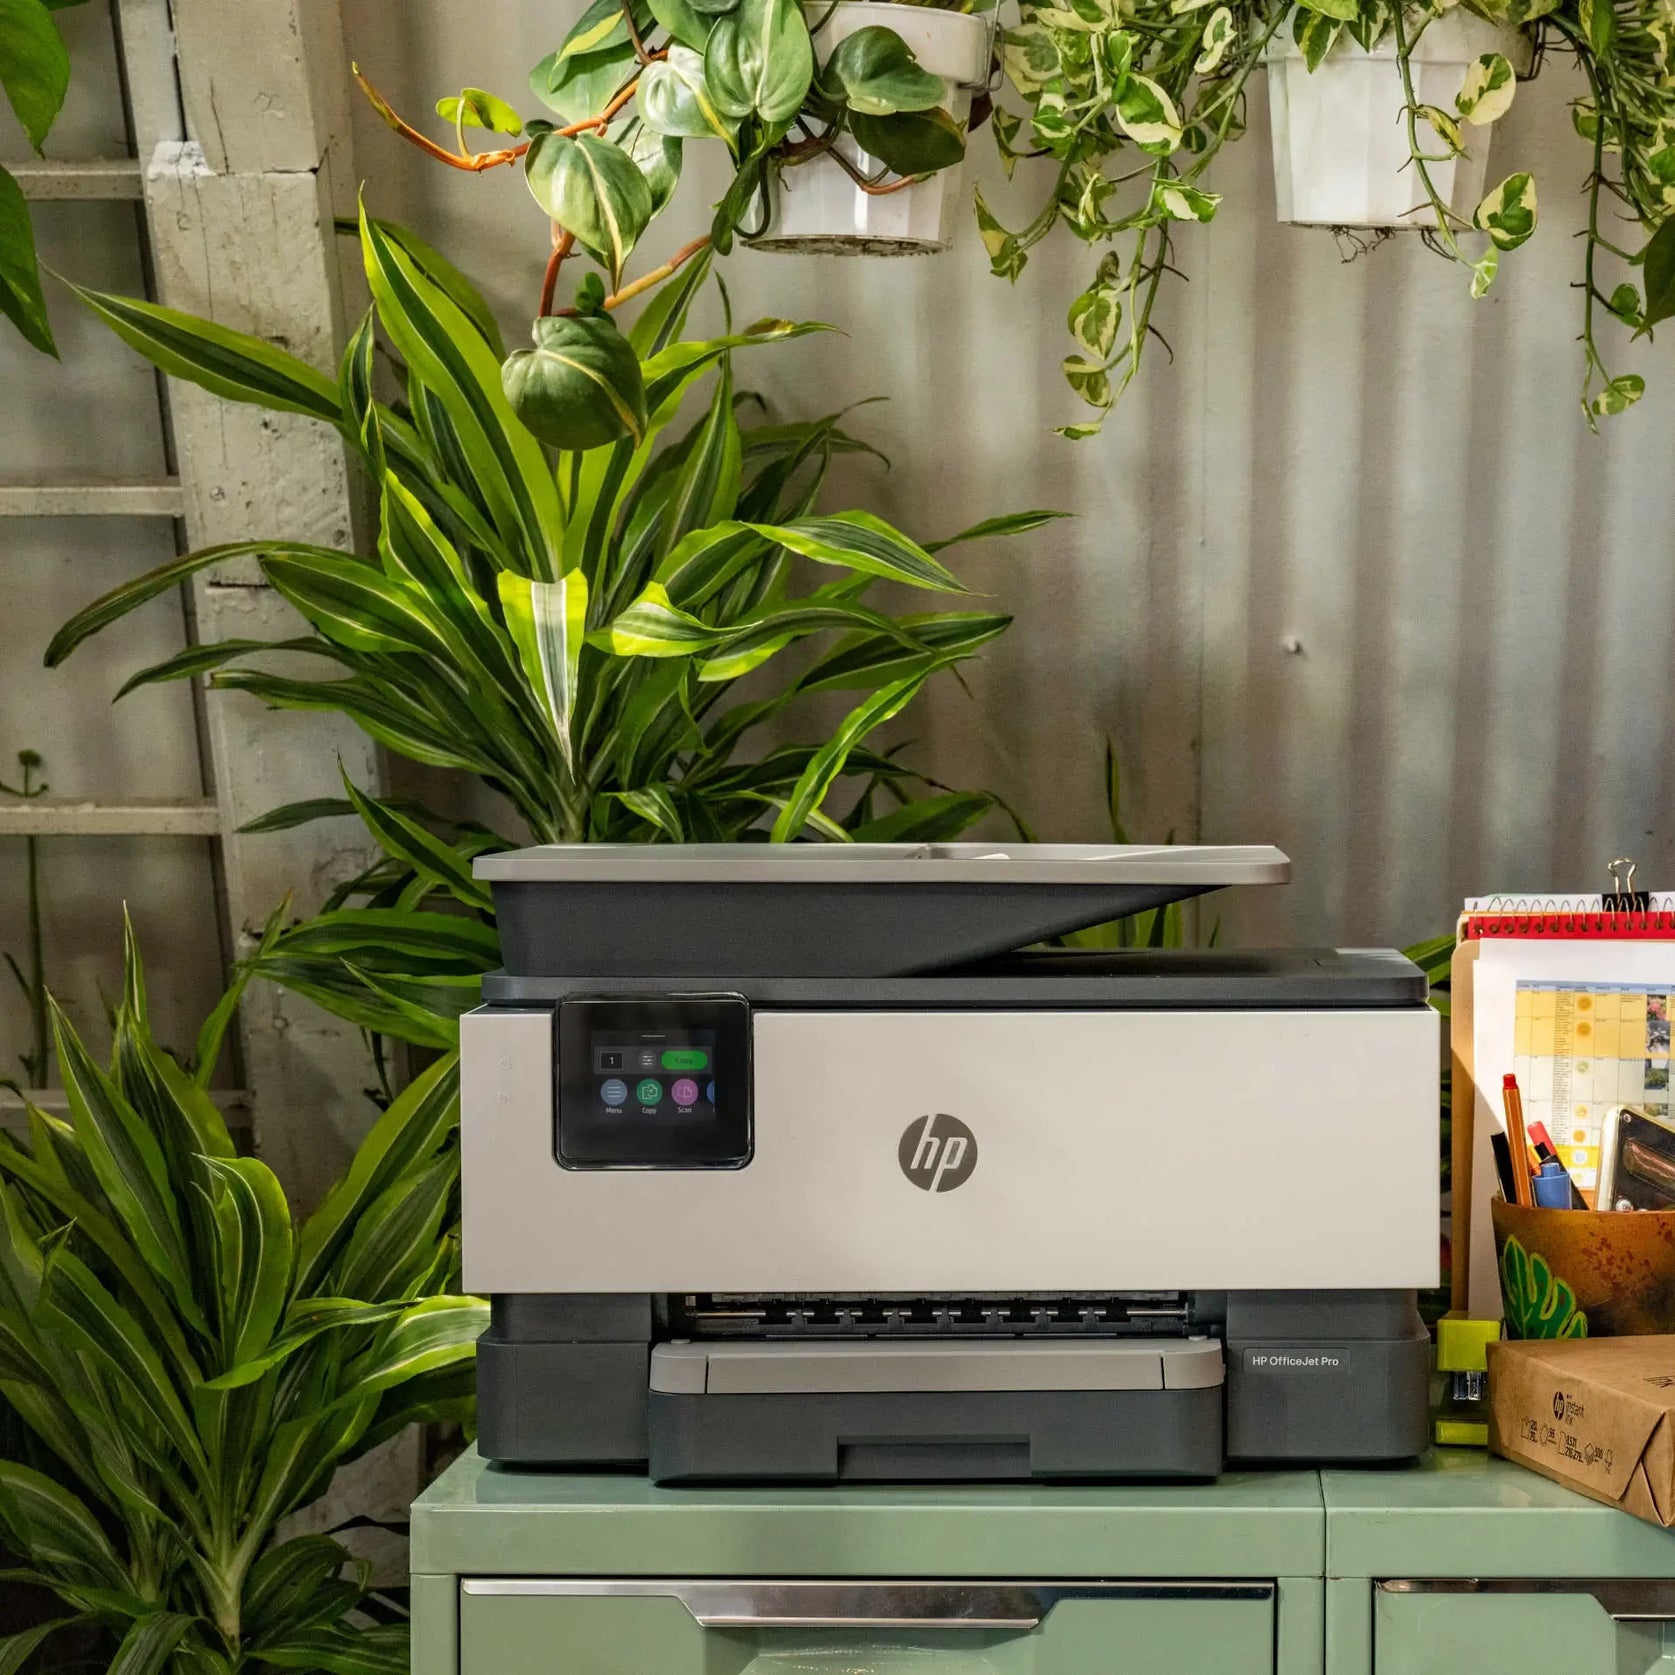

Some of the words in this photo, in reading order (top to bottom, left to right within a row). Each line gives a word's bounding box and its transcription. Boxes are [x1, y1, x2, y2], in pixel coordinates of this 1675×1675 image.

[675, 1056, 693, 1065] Copy
[605, 1106, 623, 1114] Menu
[642, 1107, 657, 1115] Copy
[677, 1106, 692, 1114] Scan
[909, 1113, 968, 1193] hp
[1252, 1356, 1267, 1366] HP
[1269, 1356, 1319, 1366] OfficeJet
[1321, 1356, 1339, 1366] Pro
